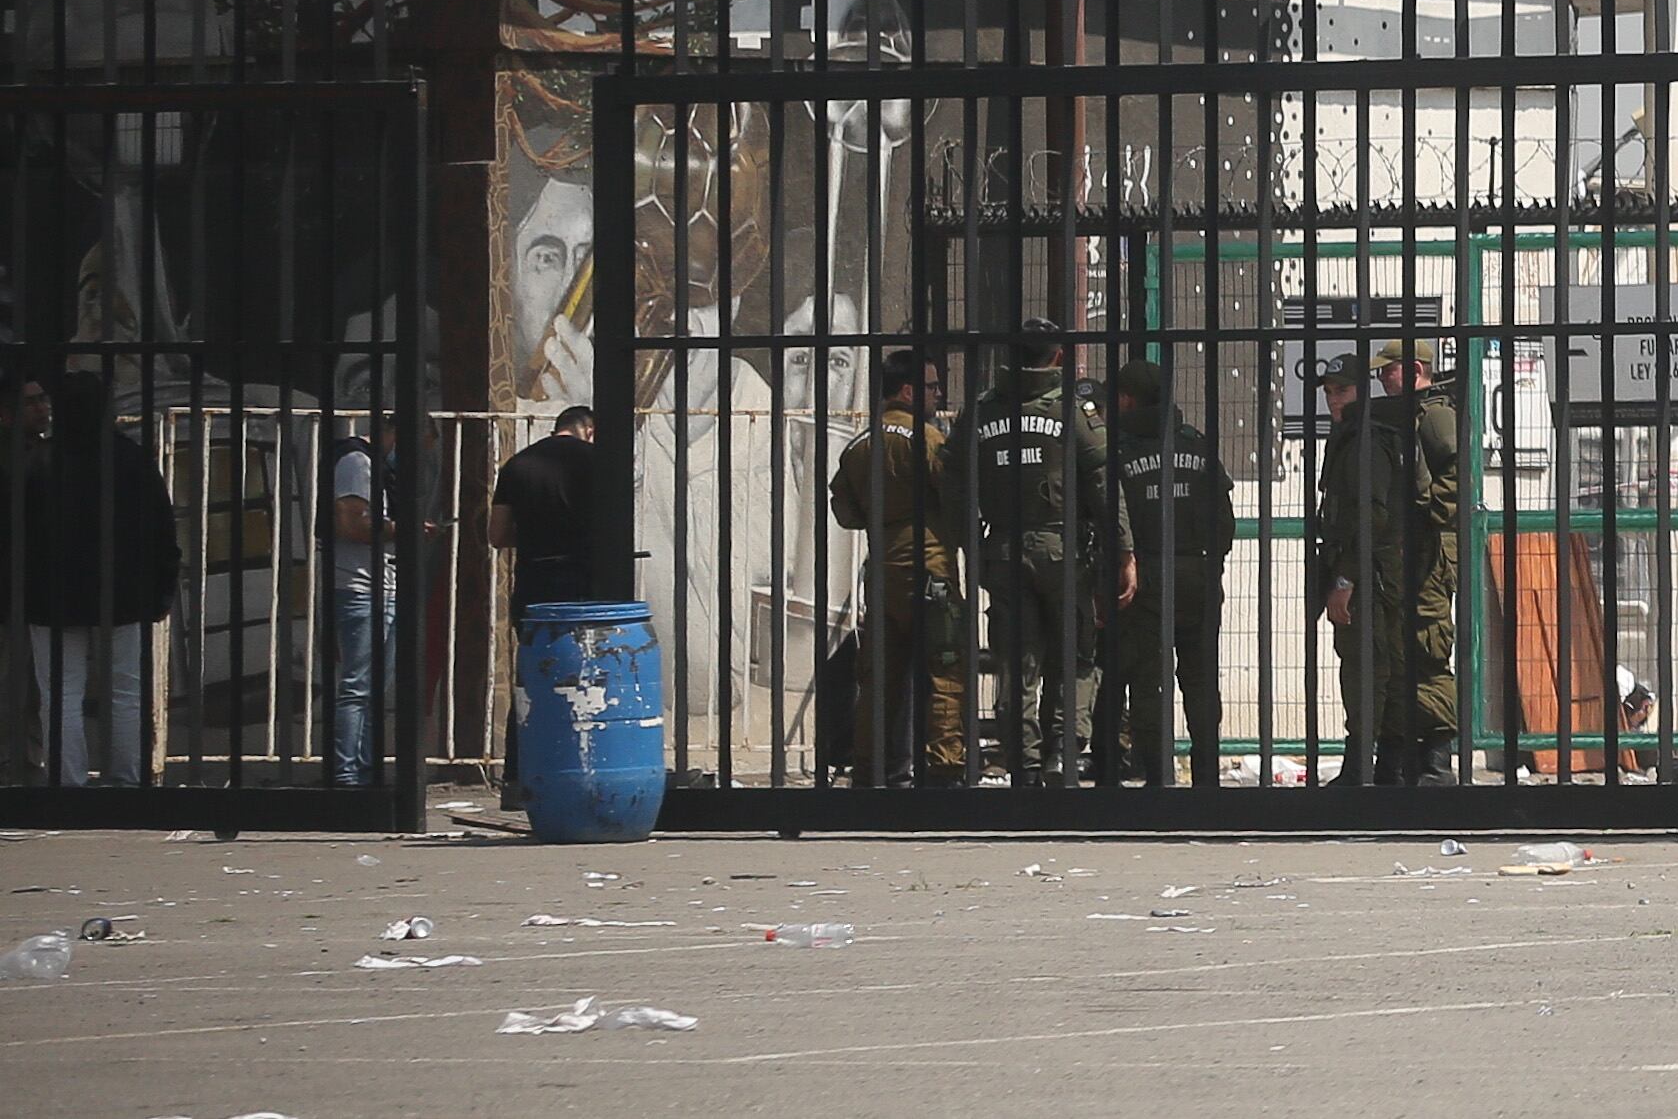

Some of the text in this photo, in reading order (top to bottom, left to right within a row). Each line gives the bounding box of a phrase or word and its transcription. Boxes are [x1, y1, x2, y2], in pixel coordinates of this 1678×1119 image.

[1630, 363, 1651, 381] LEY
[977, 414, 1064, 439] ARANEROS
[996, 449, 1010, 466] DE
